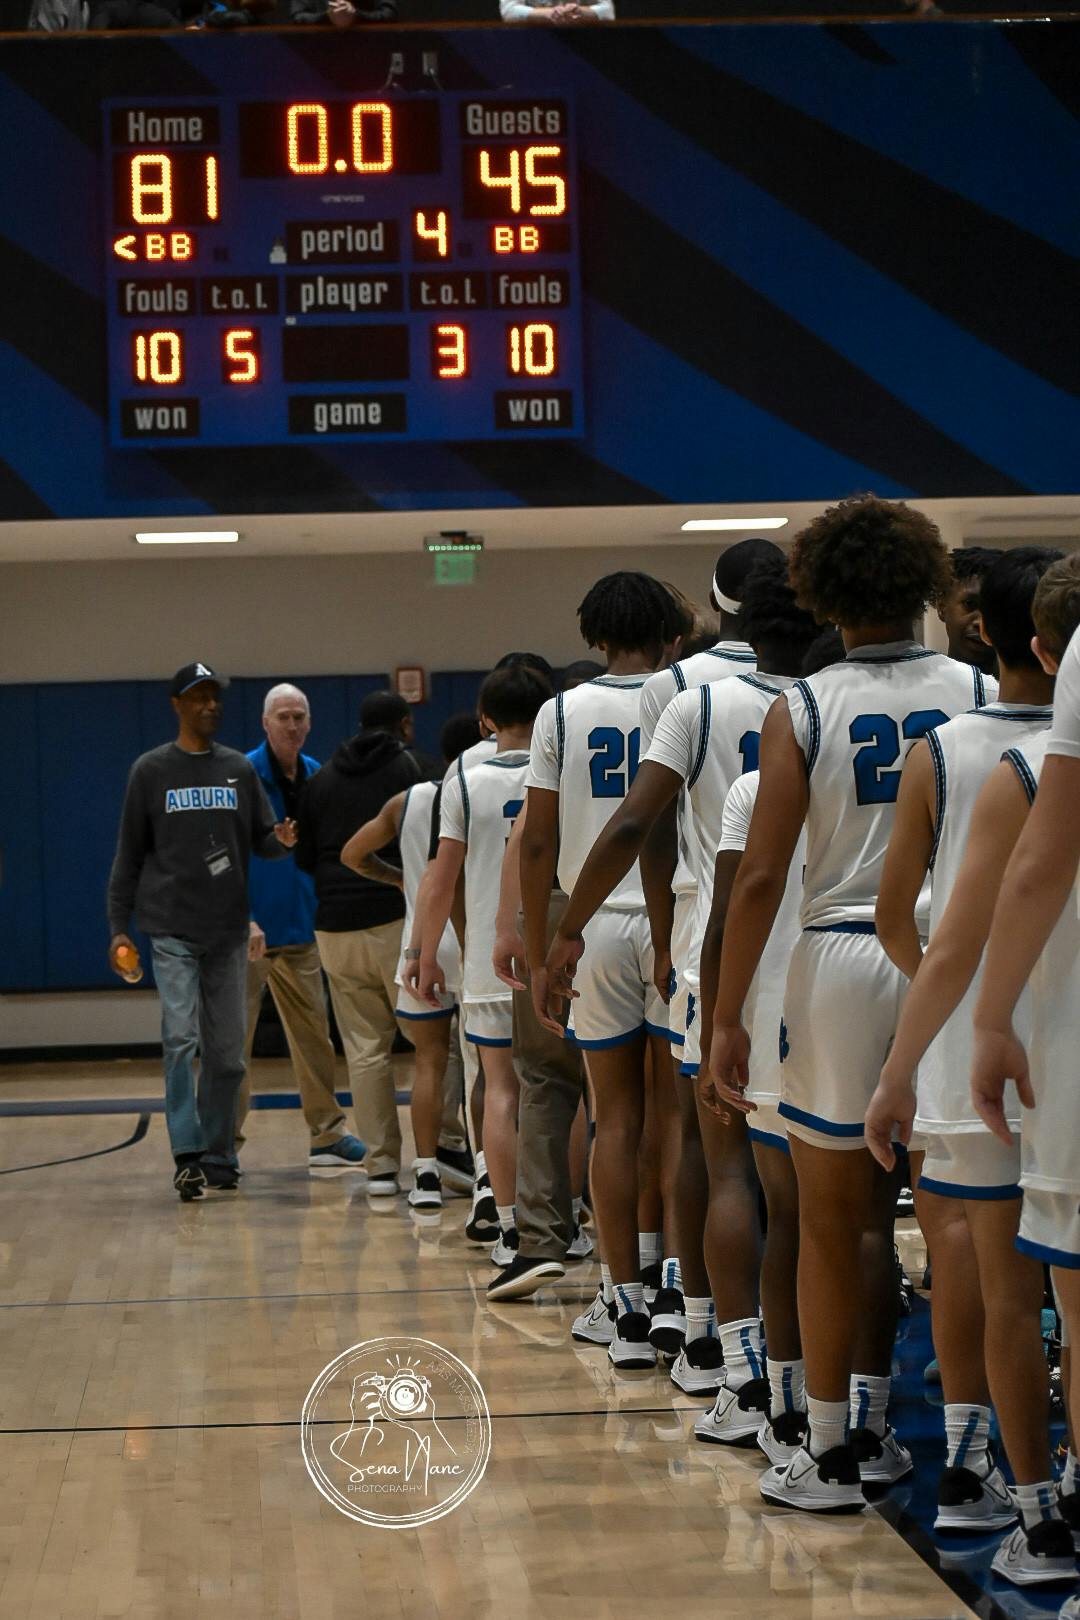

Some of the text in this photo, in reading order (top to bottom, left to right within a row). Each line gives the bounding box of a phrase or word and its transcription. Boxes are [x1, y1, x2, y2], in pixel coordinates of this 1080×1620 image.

[127, 112, 203, 143] Home
[466, 103, 560, 135] Guests
[286, 102, 394, 174] 0.0
[129, 152, 219, 225] 81
[478, 144, 567, 216] 45
[301, 222, 384, 260] period
[415, 210, 448, 257] 4
[125, 283, 189, 312] fouls
[301, 276, 388, 312] player
[499, 275, 562, 304] fouls
[135, 330, 182, 385] 10
[224, 329, 258, 382] 5
[436, 324, 466, 378] 3
[509, 322, 556, 376] 10
[134, 407, 187, 431] won
[313, 402, 382, 432] game
[508, 398, 560, 421] won
[165, 787, 238, 814] AUBURN
